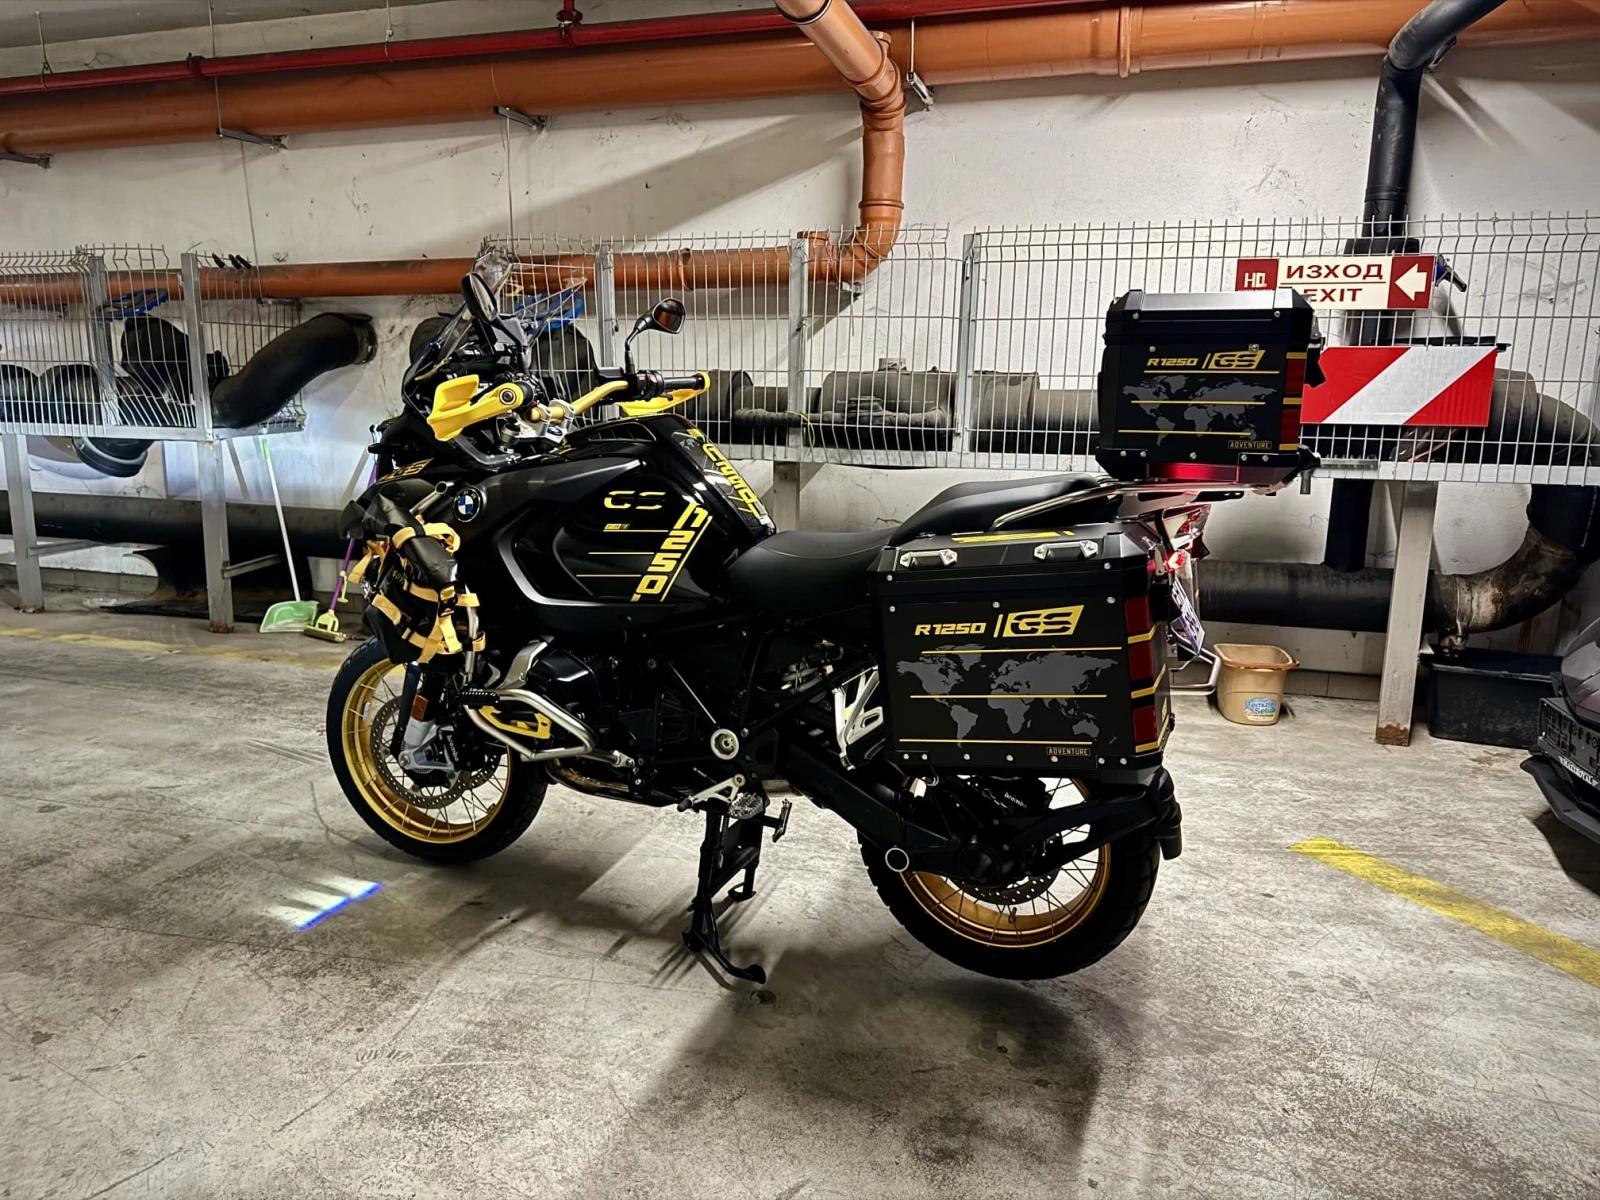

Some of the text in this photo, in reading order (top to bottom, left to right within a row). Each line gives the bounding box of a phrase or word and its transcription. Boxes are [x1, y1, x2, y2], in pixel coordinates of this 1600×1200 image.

[1286, 263, 1384, 280] ИЗХОД
[1303, 288, 1363, 302] EXIT
[1146, 351, 1264, 370] R1250 GS
[1229, 441, 1270, 449] ADVENTURE
[603, 490, 667, 511] GS
[635, 506, 710, 595] 1250
[914, 608, 1081, 636] R1250 GS
[1048, 747, 1089, 757] ADVENTURE
